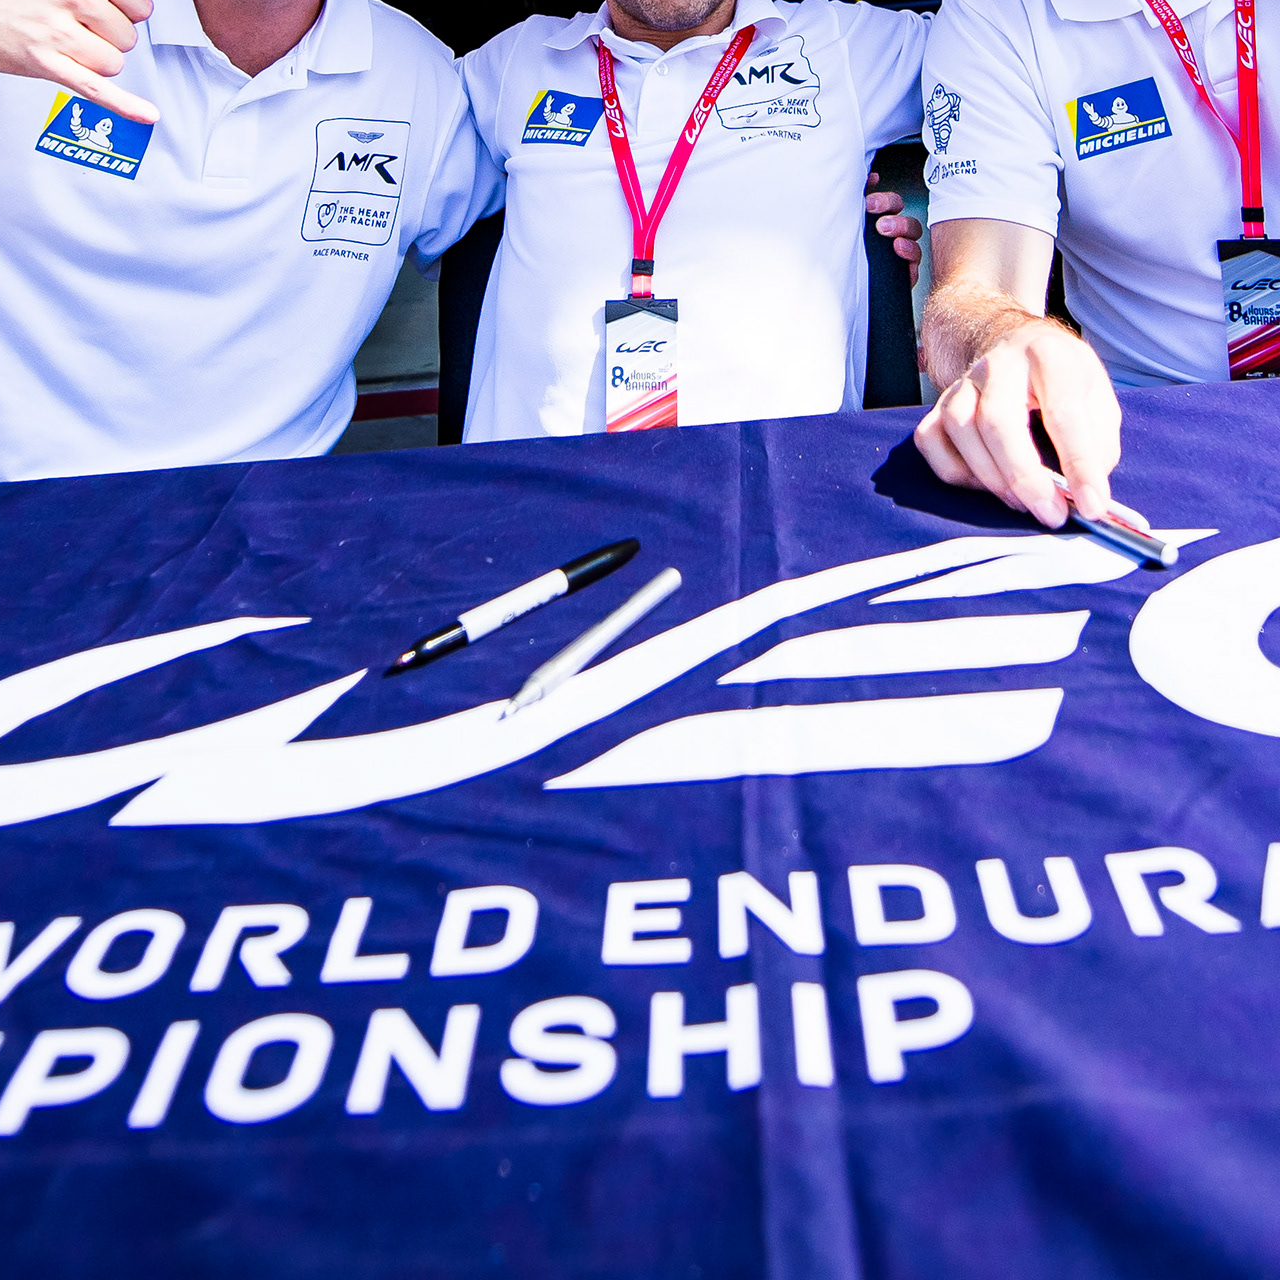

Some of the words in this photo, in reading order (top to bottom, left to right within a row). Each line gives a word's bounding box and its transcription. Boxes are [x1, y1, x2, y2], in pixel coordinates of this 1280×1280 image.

[1237, 10, 1255, 70] WEC
[711, 65, 724, 86] WORLD
[722, 35, 744, 66] ENDURANCE
[710, 57, 738, 98] CHAMPIONSHIP
[787, 98, 810, 107] HEART
[603, 98, 625, 138] WEC
[684, 98, 712, 145] WEC
[522, 126, 588, 143] MICHELIN
[1078, 121, 1167, 158] MICHELIN
[37, 135, 137, 175] MICHELIN
[323, 151, 399, 186] AMR
[947, 159, 977, 169] HEART
[339, 206, 355, 215] THE
[358, 207, 391, 219] HEART
[337, 215, 348, 224] OF
[350, 216, 388, 229] RACING
[312, 248, 330, 257] RACE
[330, 248, 370, 262] PARTNER
[1248, 305, 1275, 316] HOURS
[615, 340, 668, 353] WEC
[630, 370, 656, 381] HOURS
[625, 380, 668, 391] BAHRAIN
